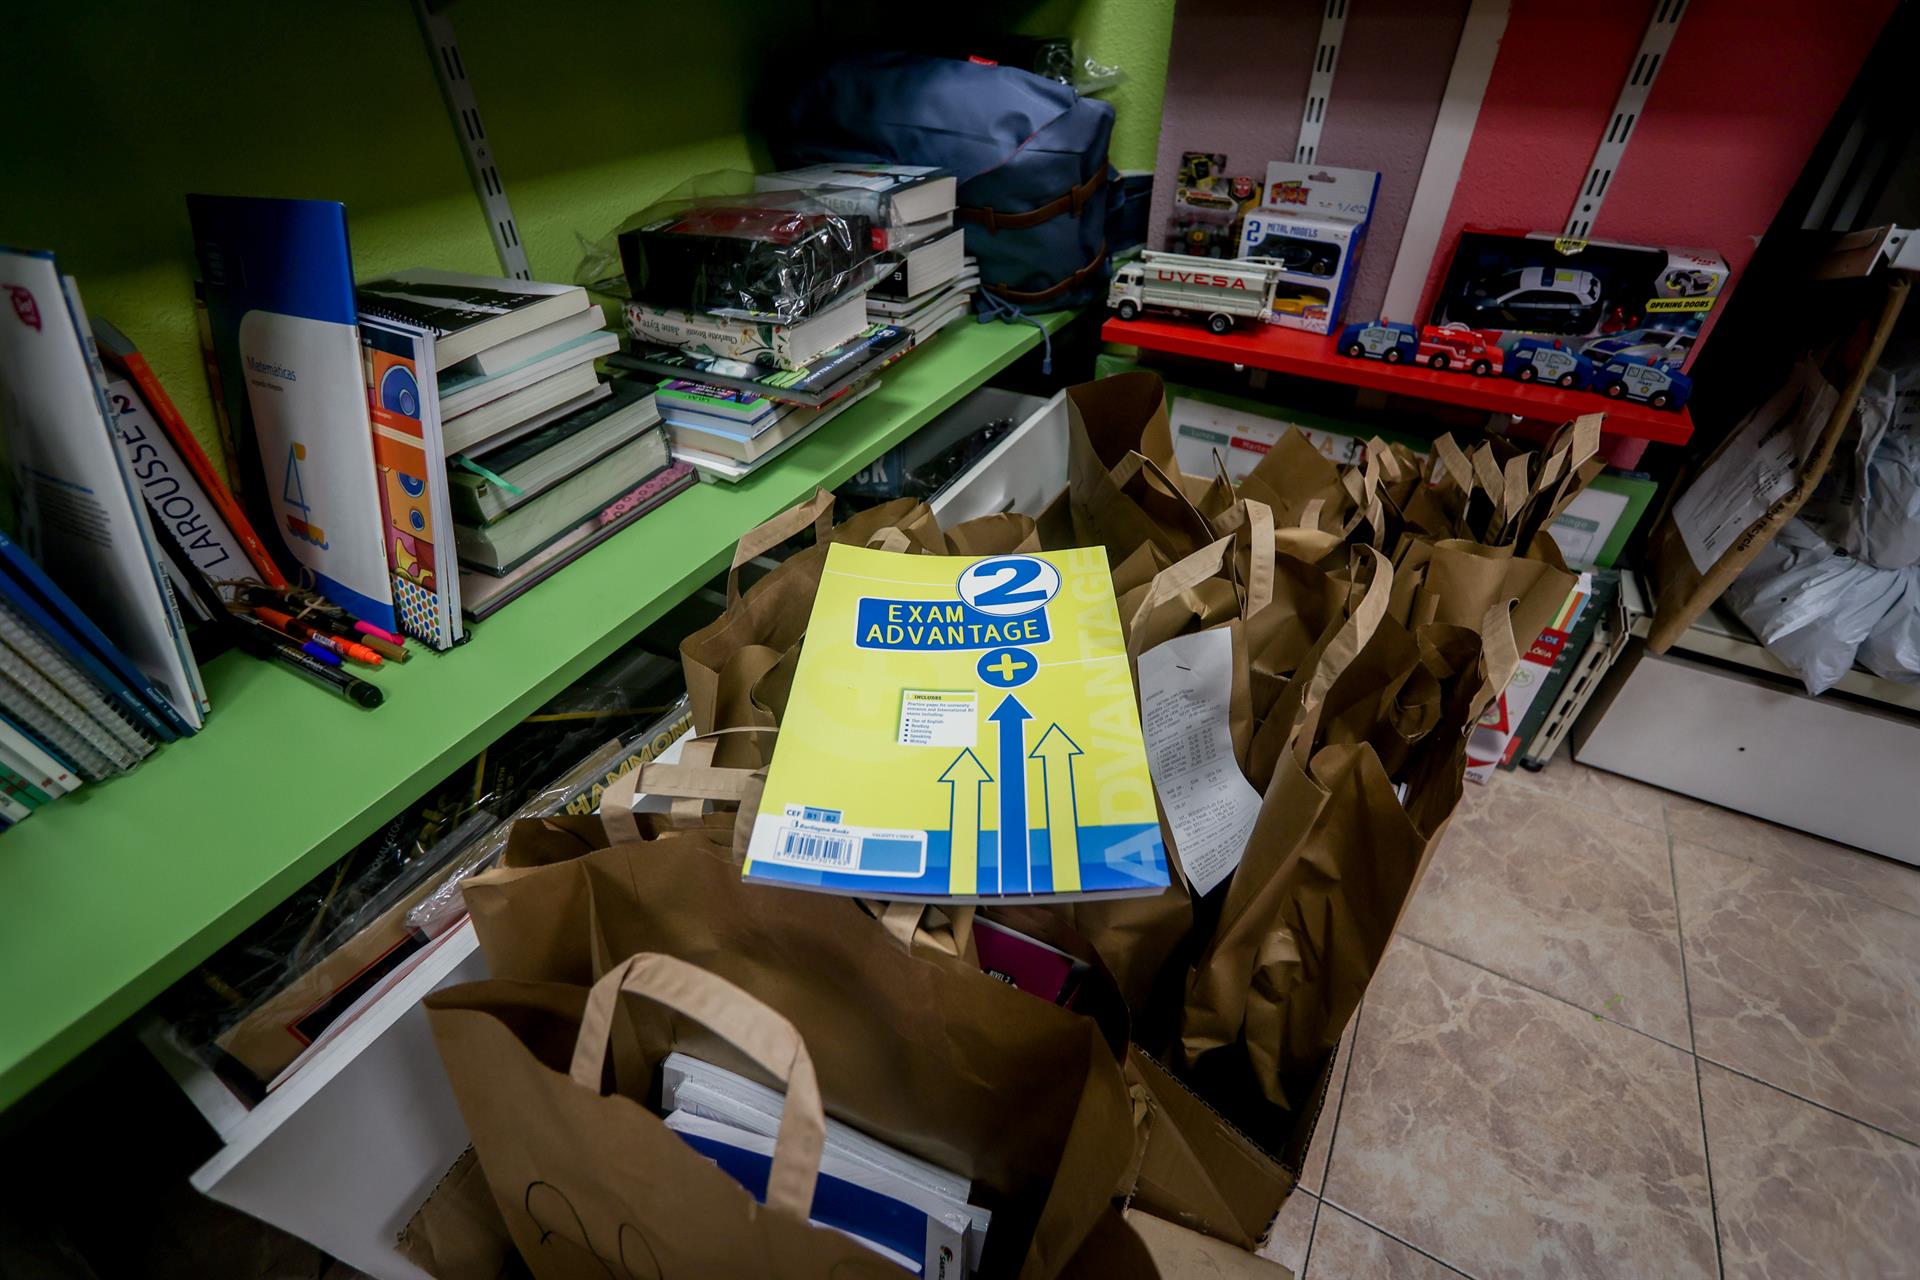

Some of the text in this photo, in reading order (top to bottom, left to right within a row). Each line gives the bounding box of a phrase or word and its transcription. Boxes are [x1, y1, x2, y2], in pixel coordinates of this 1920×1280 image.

[1247, 220, 1261, 243] 2
[1267, 223, 1318, 238] METAL MODELS
[1158, 269, 1246, 290] UVESA
[1683, 300, 1709, 308] DOORS
[642, 318, 680, 336] Jane Eyre
[708, 331, 738, 345] Charlotte
[112, 394, 137, 415] 2
[122, 424, 230, 569] LAROUSSE
[973, 559, 1049, 607] 2
[889, 604, 965, 623] EXAM
[866, 619, 1042, 646] ADVANTAGE
[786, 809, 801, 817] CEF
[826, 814, 836, 822] B2
[800, 824, 831, 834] Burlington
